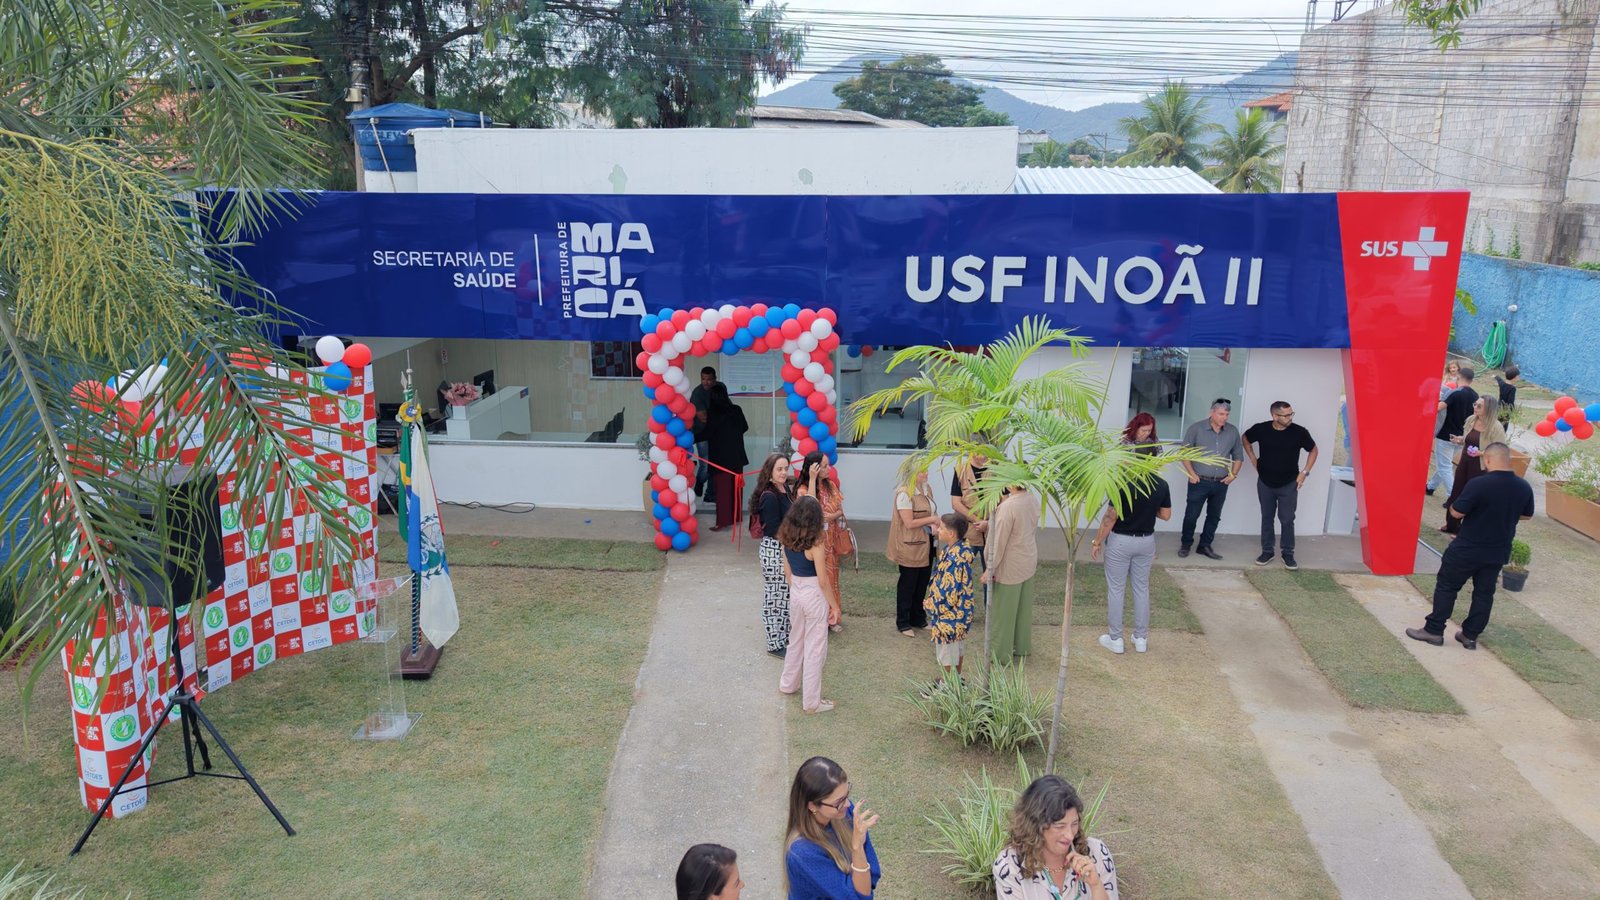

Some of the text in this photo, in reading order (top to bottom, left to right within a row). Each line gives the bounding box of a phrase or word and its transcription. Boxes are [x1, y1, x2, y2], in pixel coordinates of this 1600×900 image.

[569, 222, 655, 254] MA
[1360, 240, 1399, 257] SUS
[373, 250, 515, 267] SECRETARIA DE
[557, 222, 573, 318] PREFEITURA DE
[571, 255, 622, 286] RI
[453, 269, 517, 289] SAÚDE
[904, 244, 1263, 306] USF INOÃ II
[573, 277, 648, 319] CÁ
